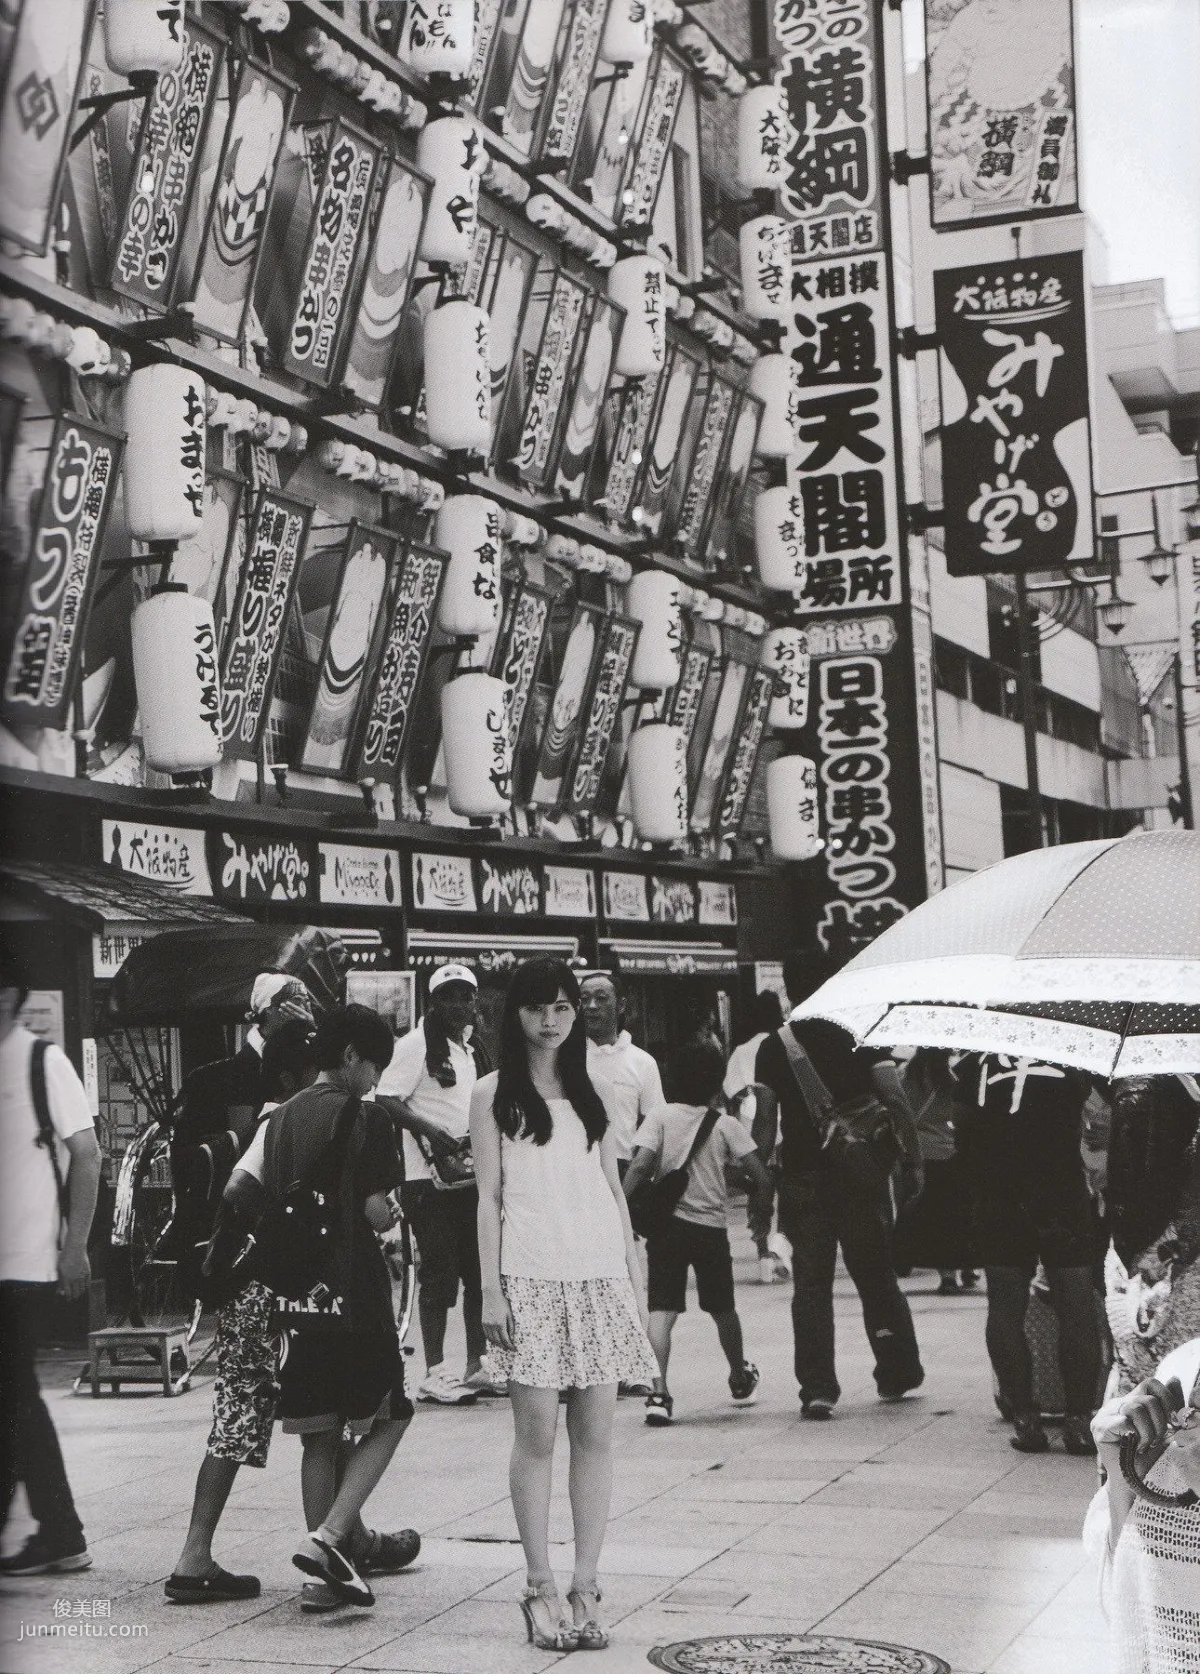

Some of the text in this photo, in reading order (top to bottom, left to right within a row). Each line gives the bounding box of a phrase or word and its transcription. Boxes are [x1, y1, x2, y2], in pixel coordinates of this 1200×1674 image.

[781, 46, 870, 212] 横綱
[976, 115, 1019, 178] 横綱
[291, 136, 358, 360] 名物串かつ
[791, 259, 880, 301] 大相撲
[953, 275, 1063, 312] 大阪物産
[792, 301, 888, 556] 通天閣
[957, 328, 1066, 556] みやげ堂
[802, 557, 894, 608] 場所
[805, 615, 896, 656] 新世界
[816, 655, 896, 899] 日本一の串かつ
[128, 834, 192, 879] 大阪物産
[222, 831, 302, 898] みやげ堂
